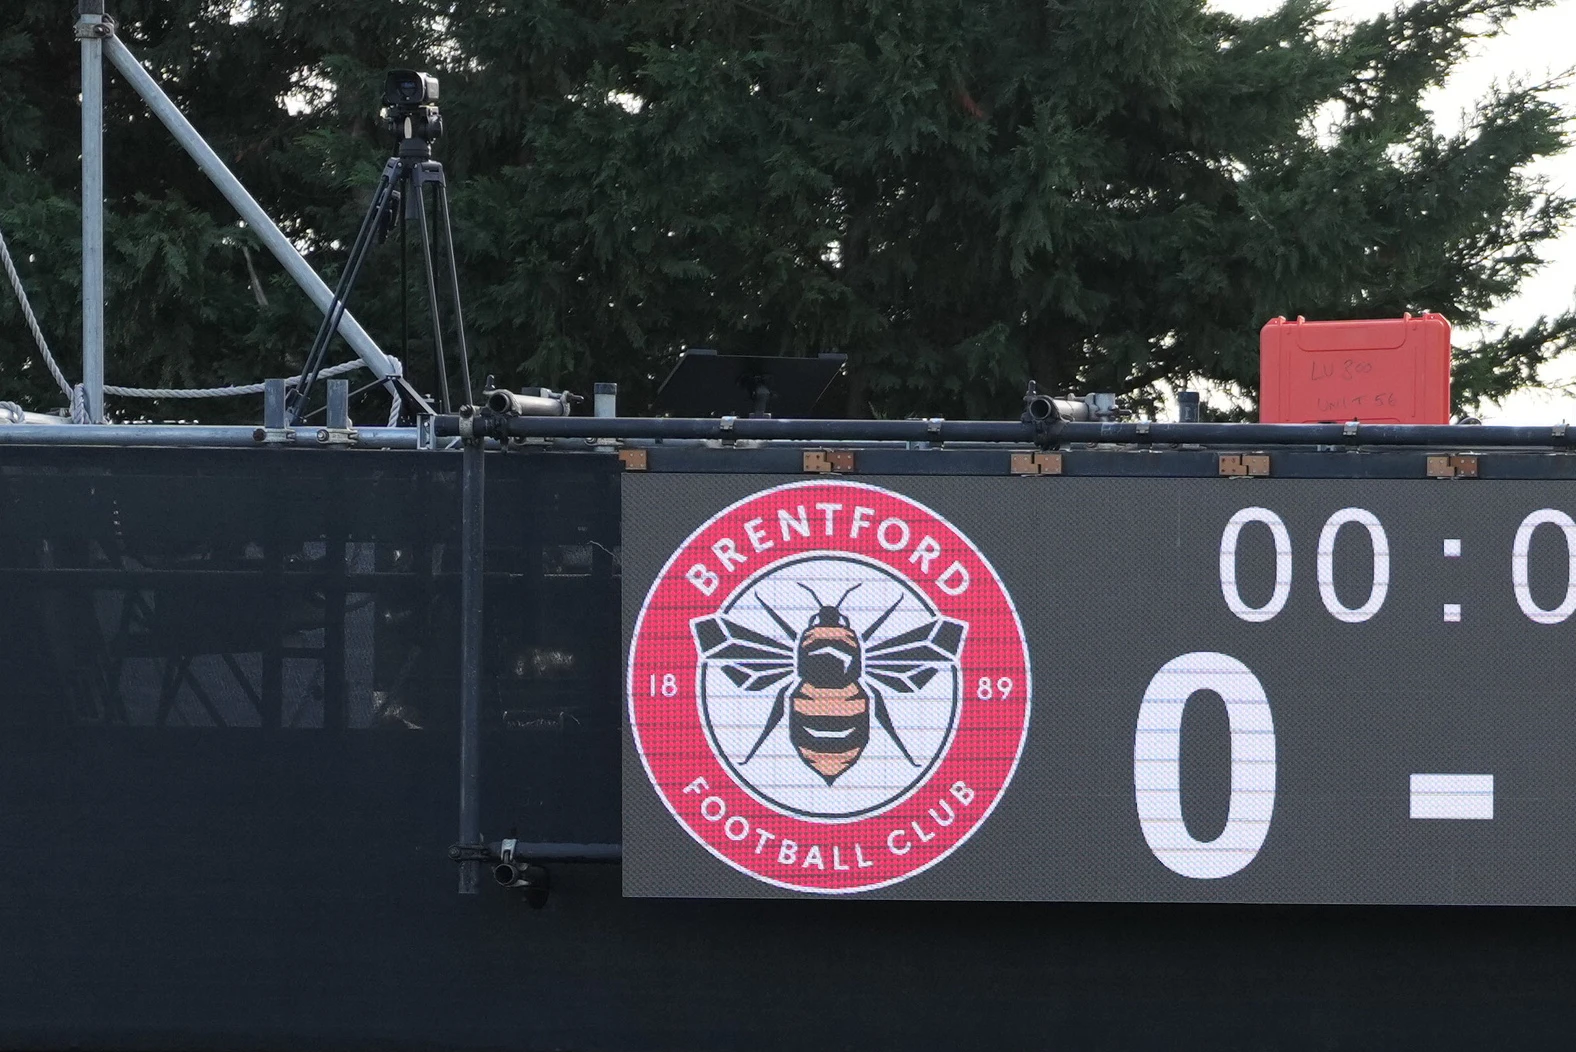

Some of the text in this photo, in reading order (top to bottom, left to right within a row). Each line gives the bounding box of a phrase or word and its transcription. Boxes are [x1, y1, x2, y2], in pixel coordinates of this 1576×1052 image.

[686, 502, 970, 597] BRENTFORD
[649, 673, 1013, 701] 18 89
[1133, 651, 1277, 880] 0
[682, 776, 976, 871] FOOTBALL CLUB
